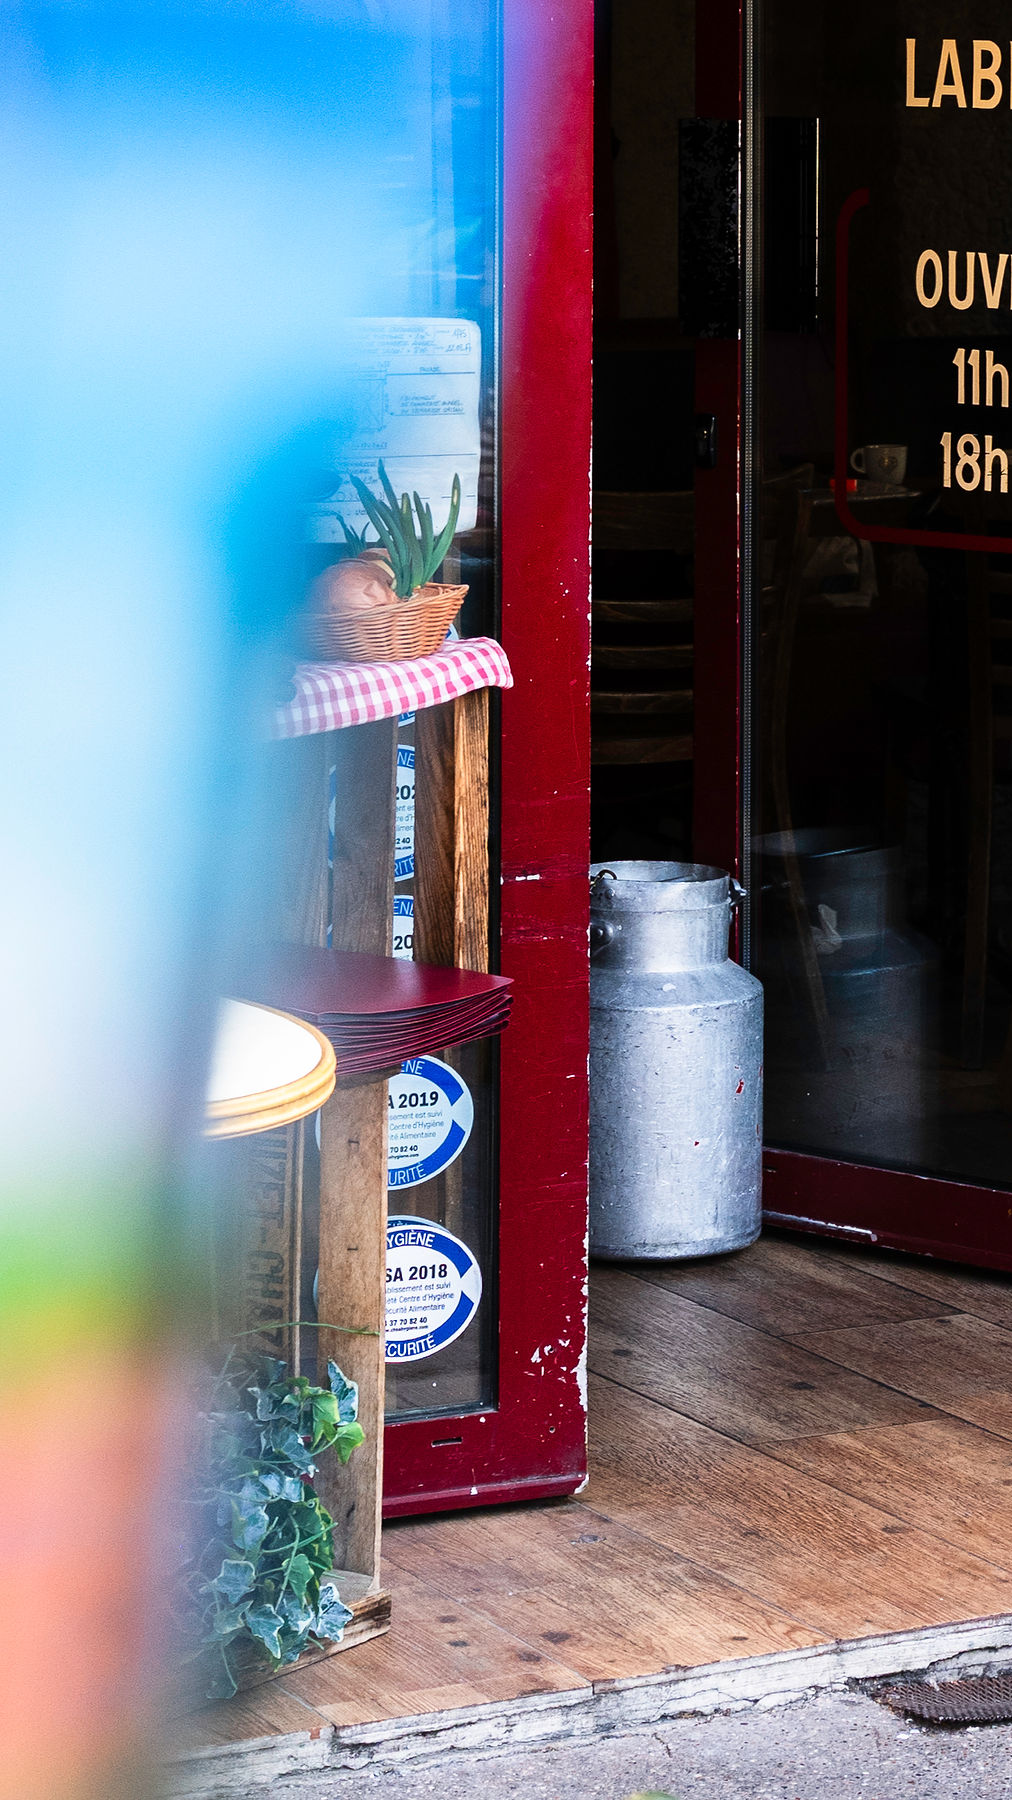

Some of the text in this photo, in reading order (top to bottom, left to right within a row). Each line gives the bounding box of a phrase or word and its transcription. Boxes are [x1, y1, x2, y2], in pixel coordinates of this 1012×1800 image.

[953, 348, 1010, 408] 11h
[940, 431, 1009, 493] 18h
[398, 1091, 439, 1109] 2019
[388, 1162, 427, 1186] URITÉ
[387, 1229, 436, 1248] YGIÈNE
[408, 1263, 448, 1281] 2018
[386, 1333, 437, 1357] CURITÉ
